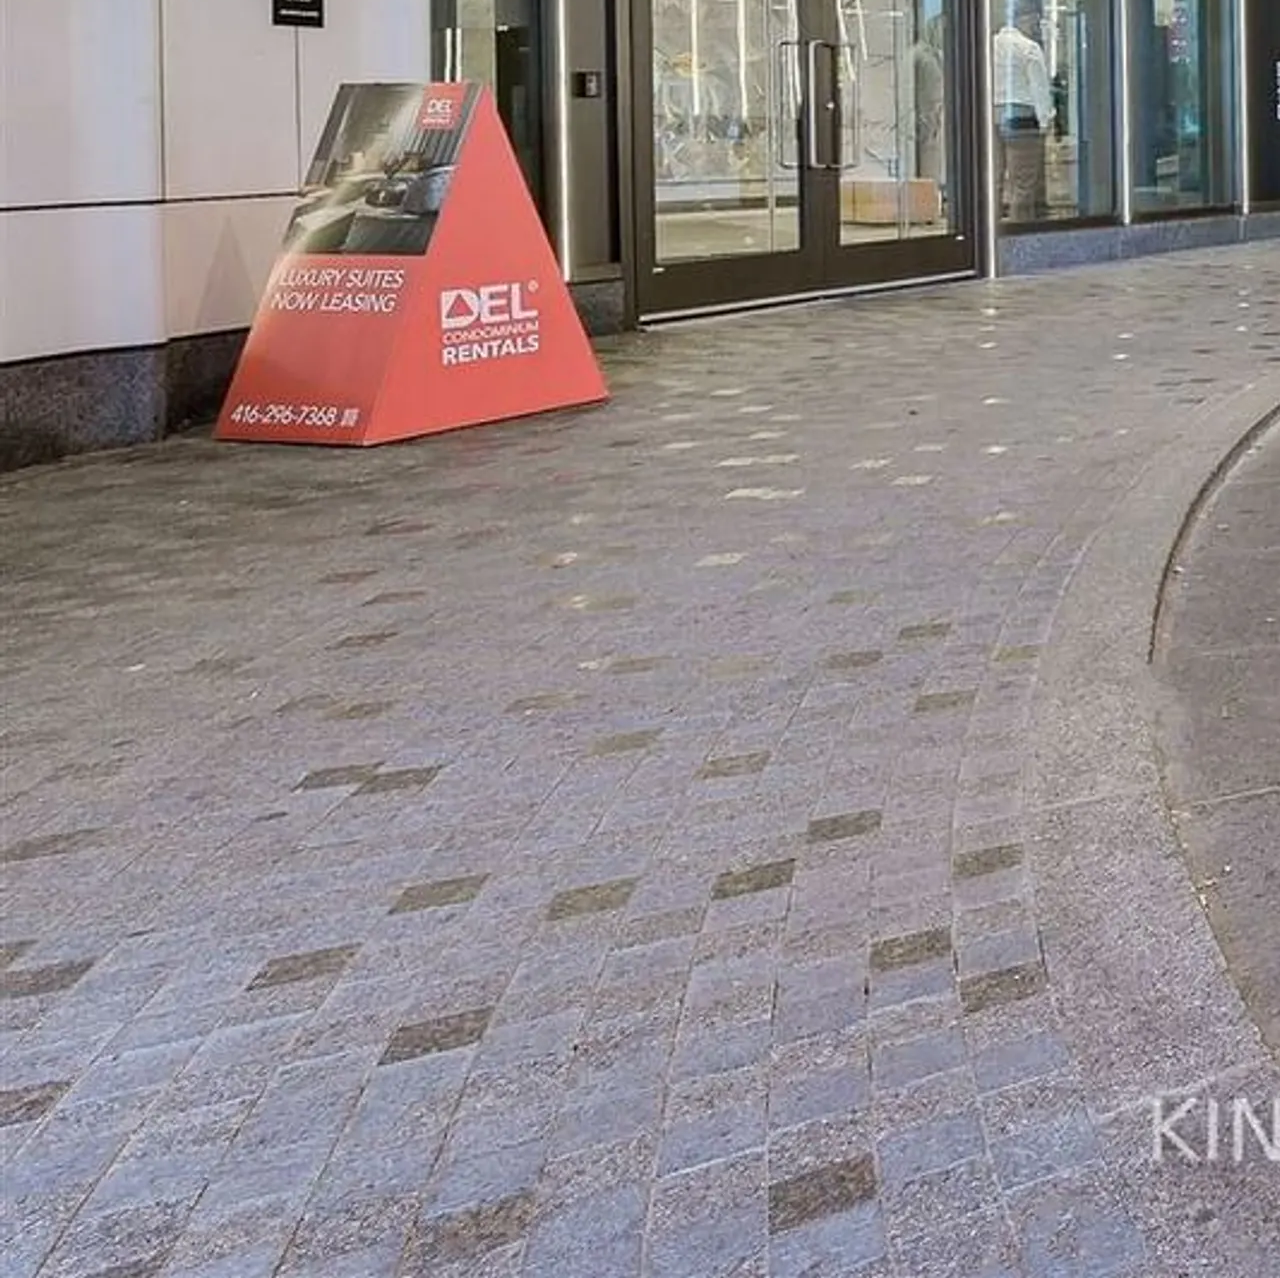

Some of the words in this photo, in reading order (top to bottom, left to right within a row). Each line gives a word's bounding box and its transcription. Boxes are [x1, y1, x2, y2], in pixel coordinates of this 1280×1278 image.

[280, 269, 347, 286] LUXURY
[345, 269, 405, 288] SUITES
[270, 292, 321, 310] NOW
[319, 293, 398, 312] LEASING
[442, 334, 539, 366] RENTALS
